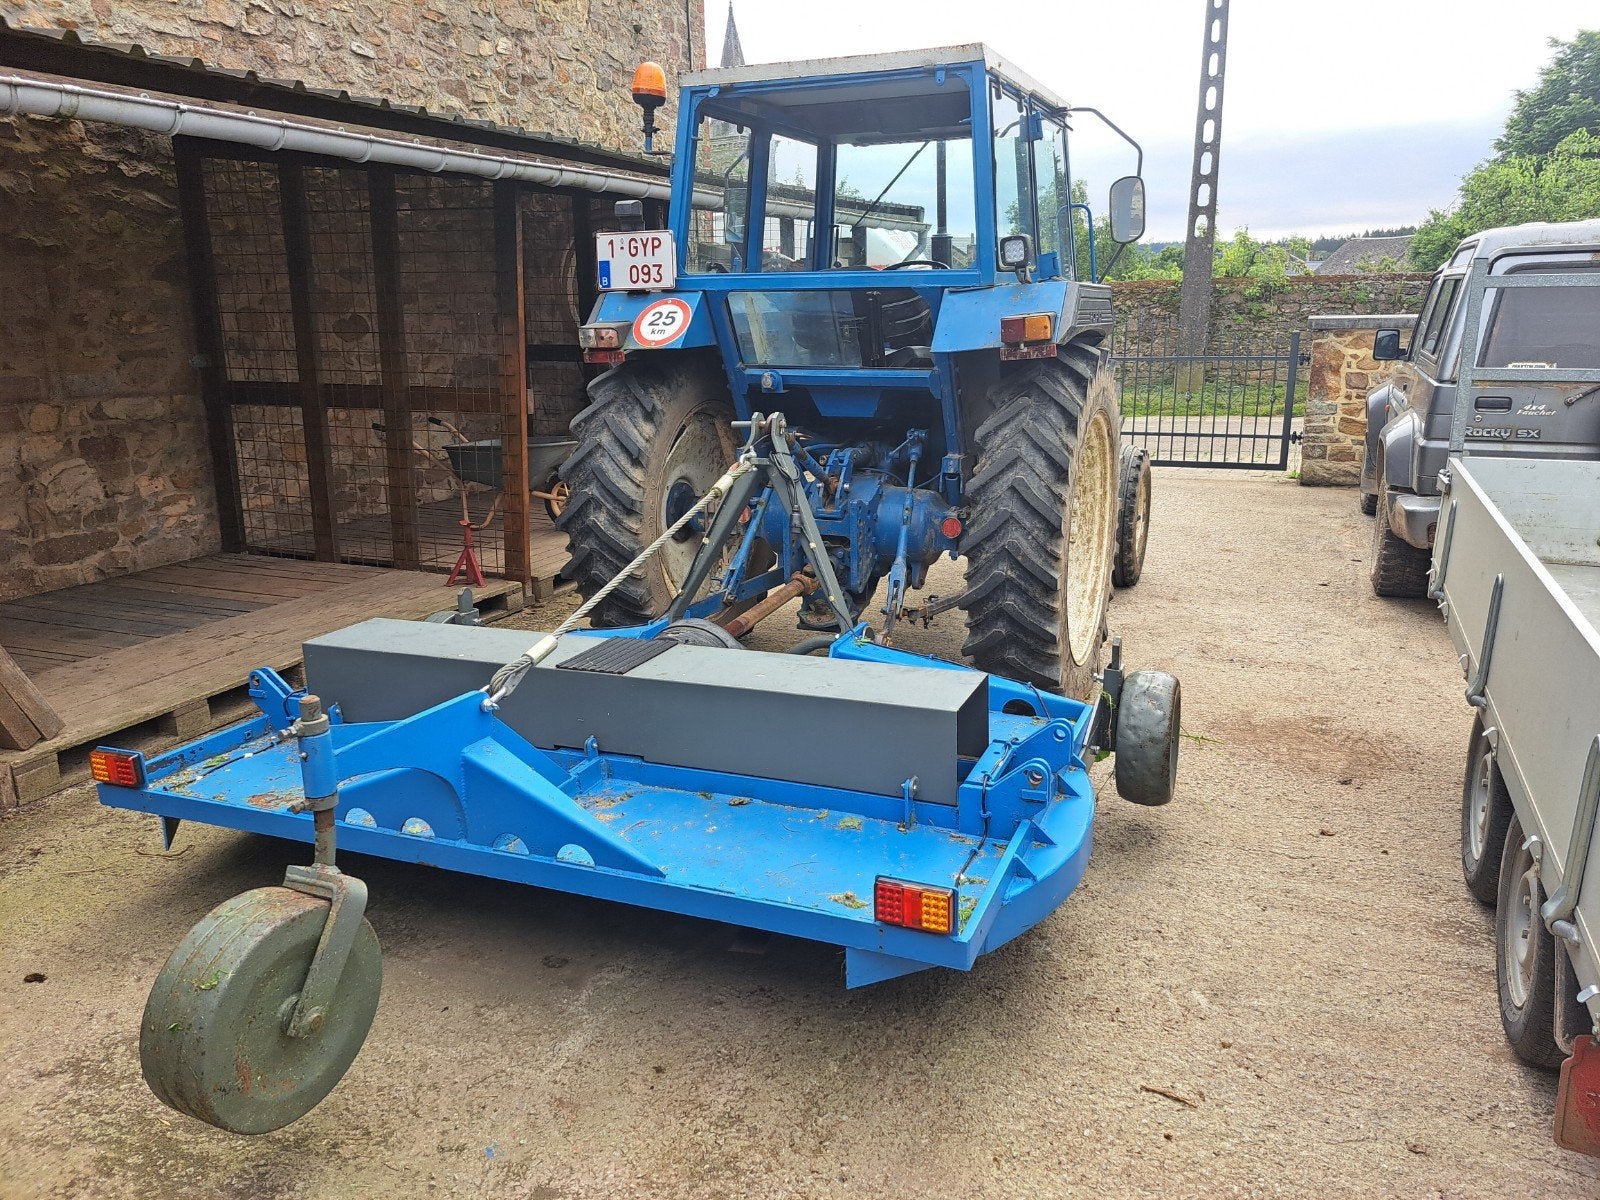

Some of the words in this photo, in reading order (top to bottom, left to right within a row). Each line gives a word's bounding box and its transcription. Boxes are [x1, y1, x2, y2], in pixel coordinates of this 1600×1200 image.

[629, 264, 663, 284] 093
[602, 276, 609, 286] B
[648, 311, 678, 327] 25
[1517, 429, 1540, 438] SX
